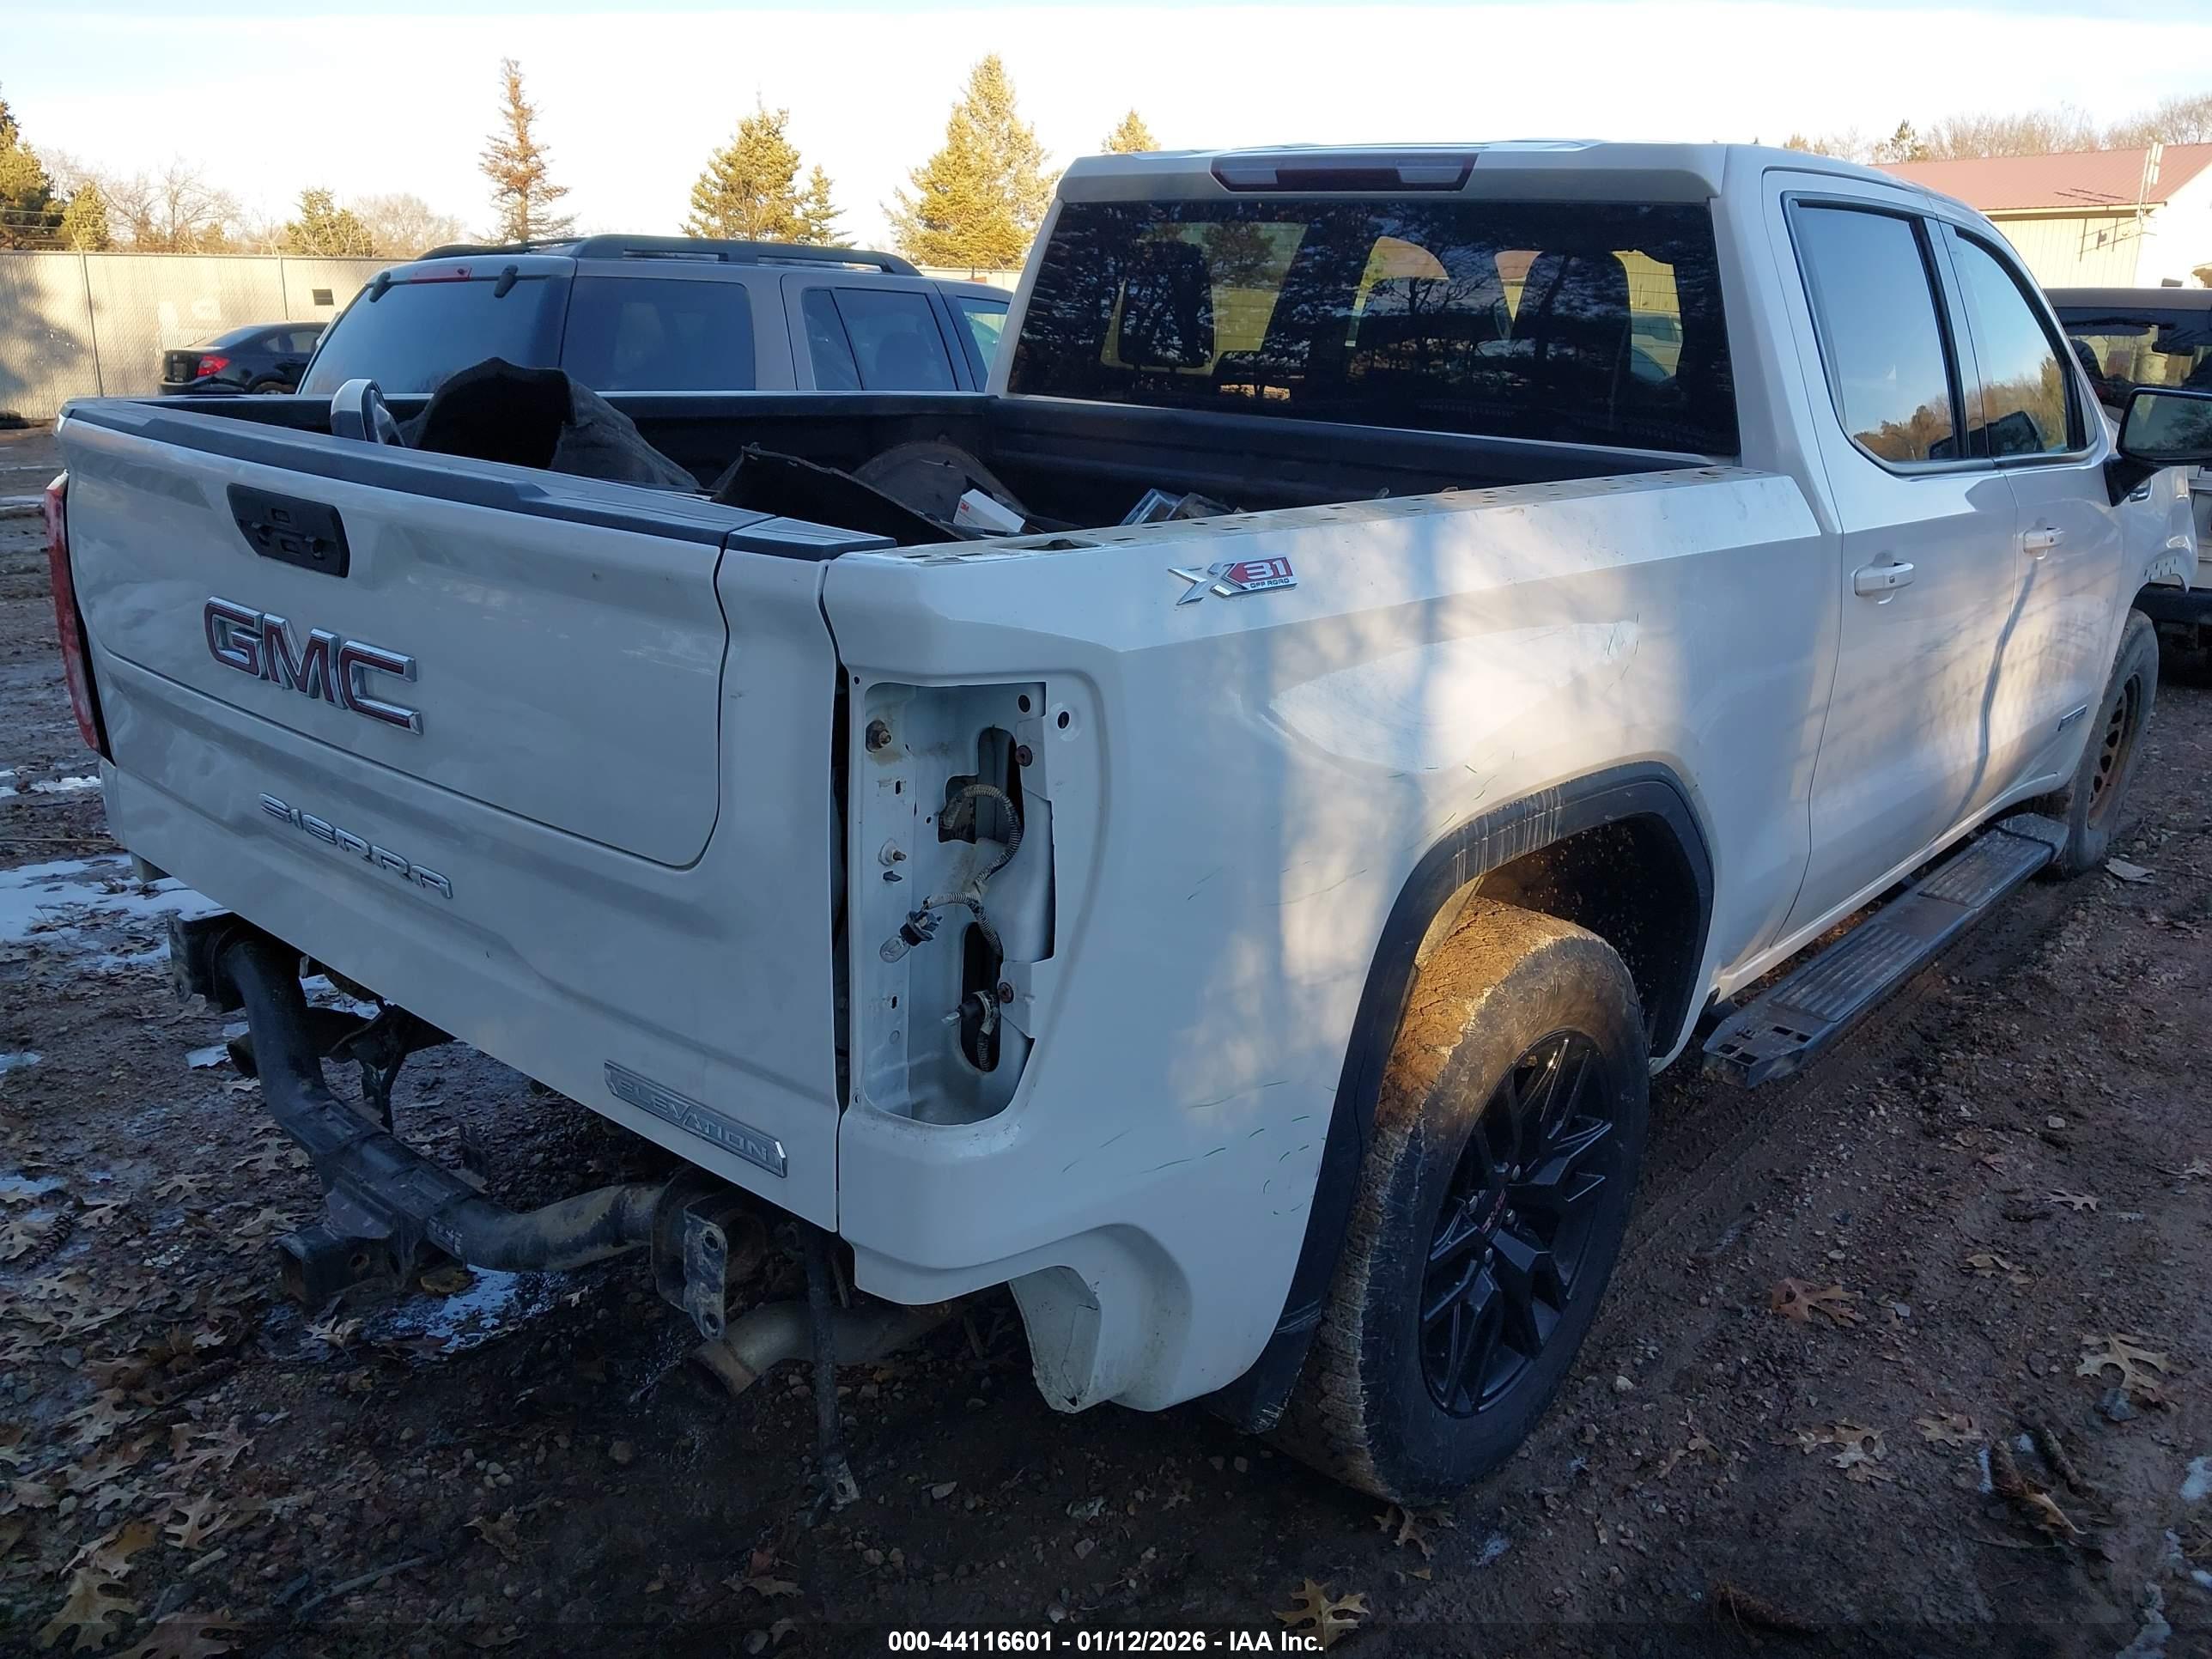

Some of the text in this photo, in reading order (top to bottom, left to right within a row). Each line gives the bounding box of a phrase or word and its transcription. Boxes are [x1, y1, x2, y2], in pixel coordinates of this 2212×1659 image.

[1267, 577, 1291, 586] ROAD
[204, 596, 423, 735] GMC
[258, 792, 453, 900] SIERRA
[618, 1079, 769, 1162] ELEVATION
